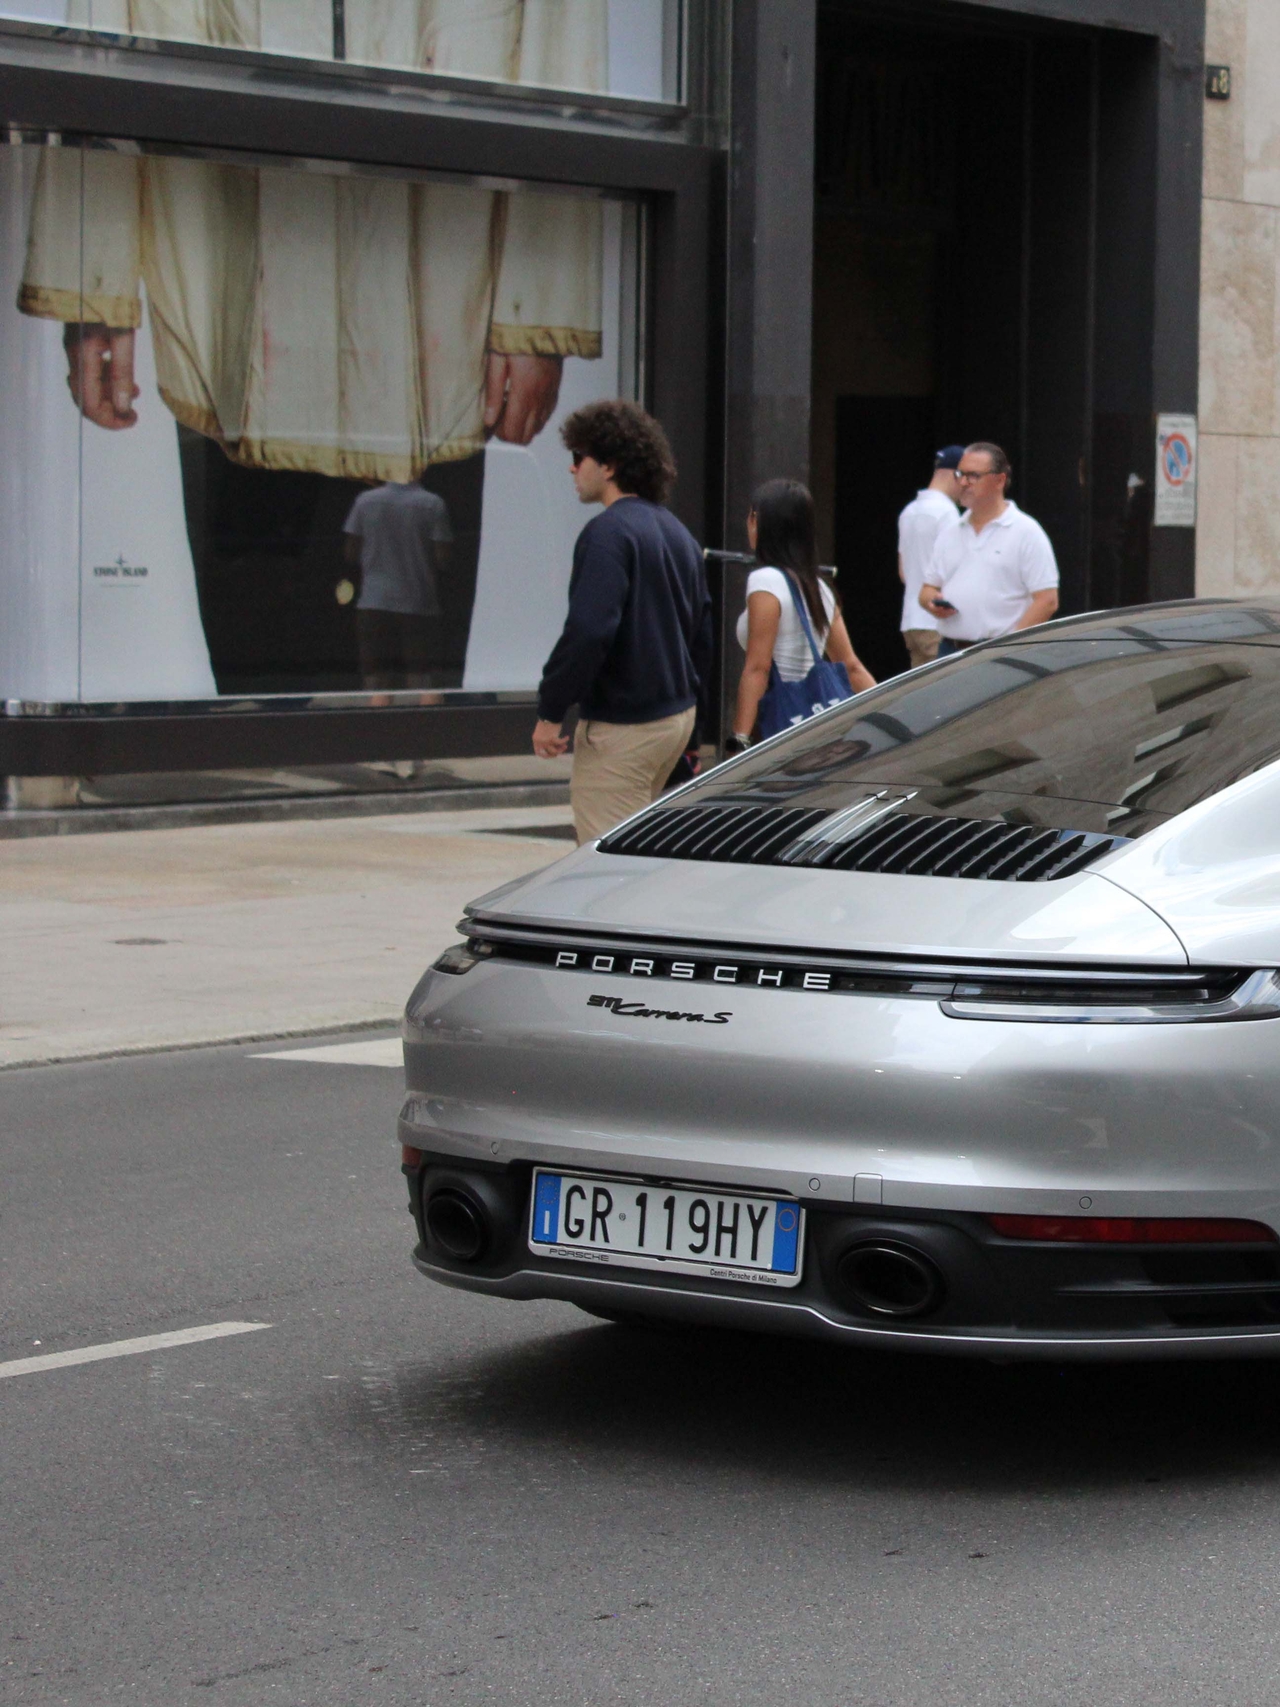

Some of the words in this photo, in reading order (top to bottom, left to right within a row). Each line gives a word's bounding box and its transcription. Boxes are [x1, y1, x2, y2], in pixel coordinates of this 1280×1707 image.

[555, 951, 831, 990] PORSCHE
[610, 1002, 704, 1022] Carrera
[703, 1011, 733, 1023] S
[549, 1248, 610, 1262] PORSCHE
[709, 1268, 728, 1278] Centri
[728, 1270, 751, 1281] Porsche
[751, 1273, 757, 1281] di
[757, 1274, 778, 1284] Milano
